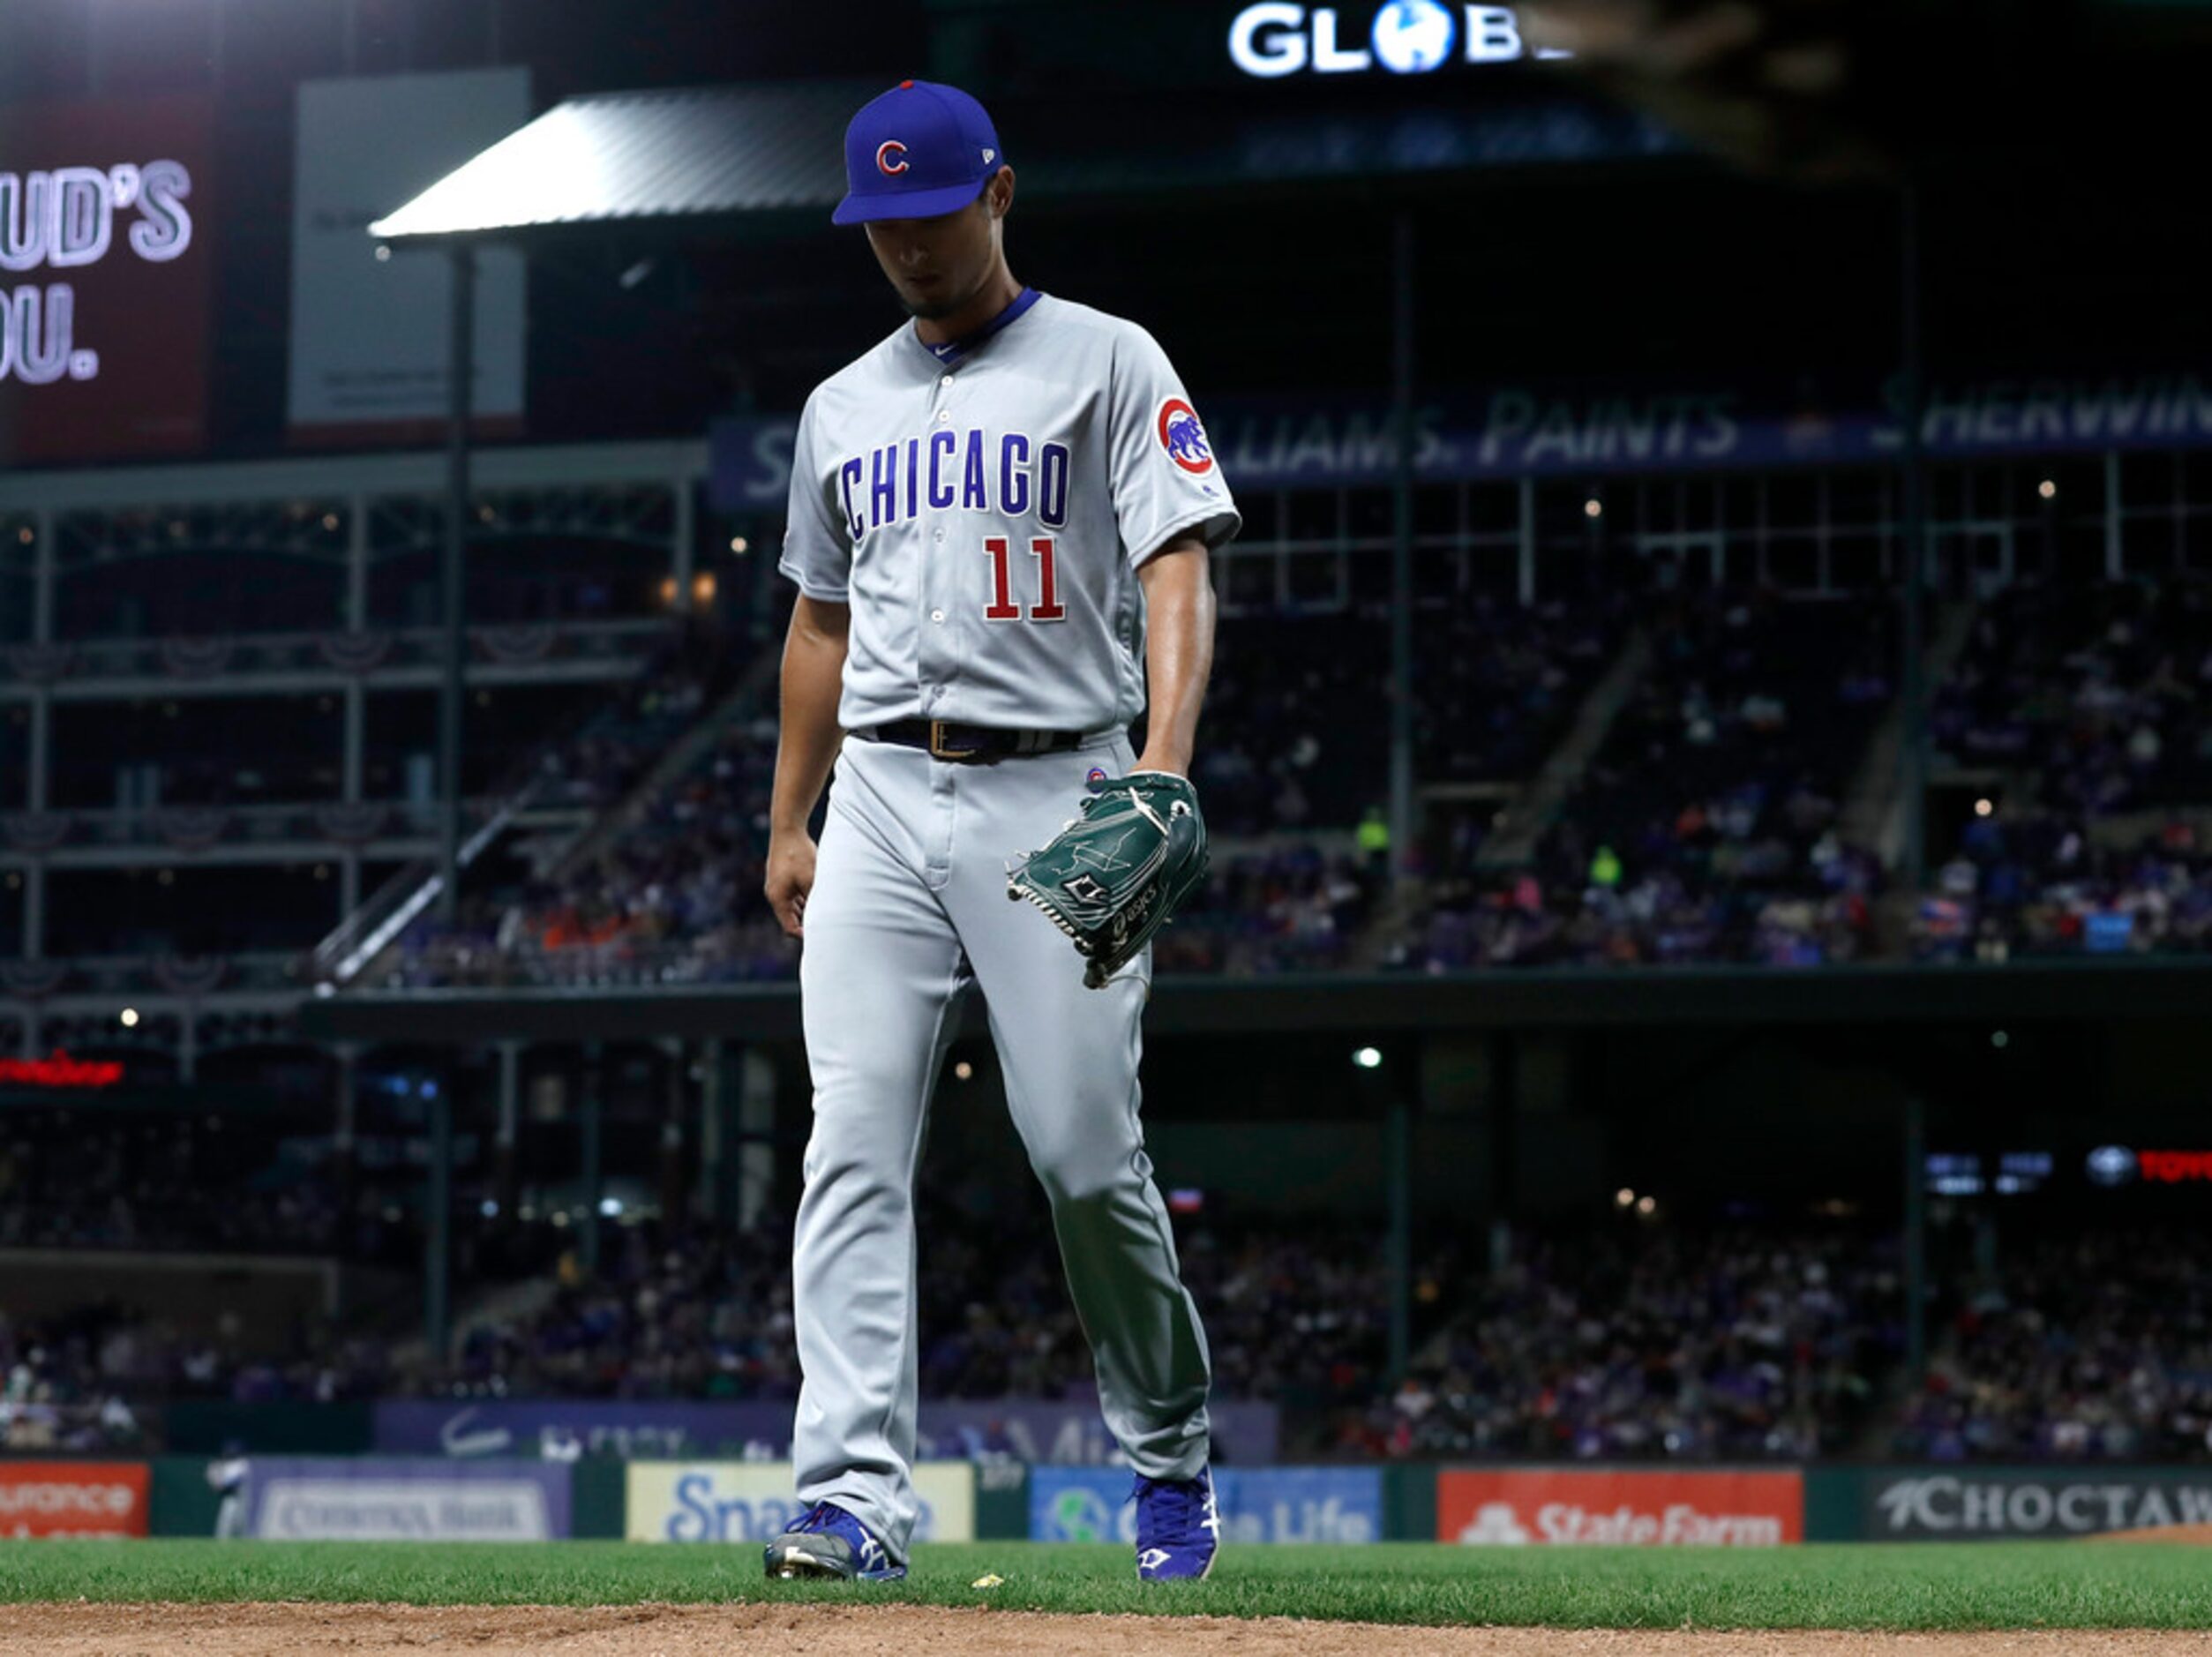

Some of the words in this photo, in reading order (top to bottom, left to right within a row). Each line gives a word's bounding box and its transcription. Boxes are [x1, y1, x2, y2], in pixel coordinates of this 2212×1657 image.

[876, 140, 910, 176] C
[0, 282, 99, 384] U.
[841, 428, 1070, 543] CHICAGO
[982, 536, 1066, 621] 11
